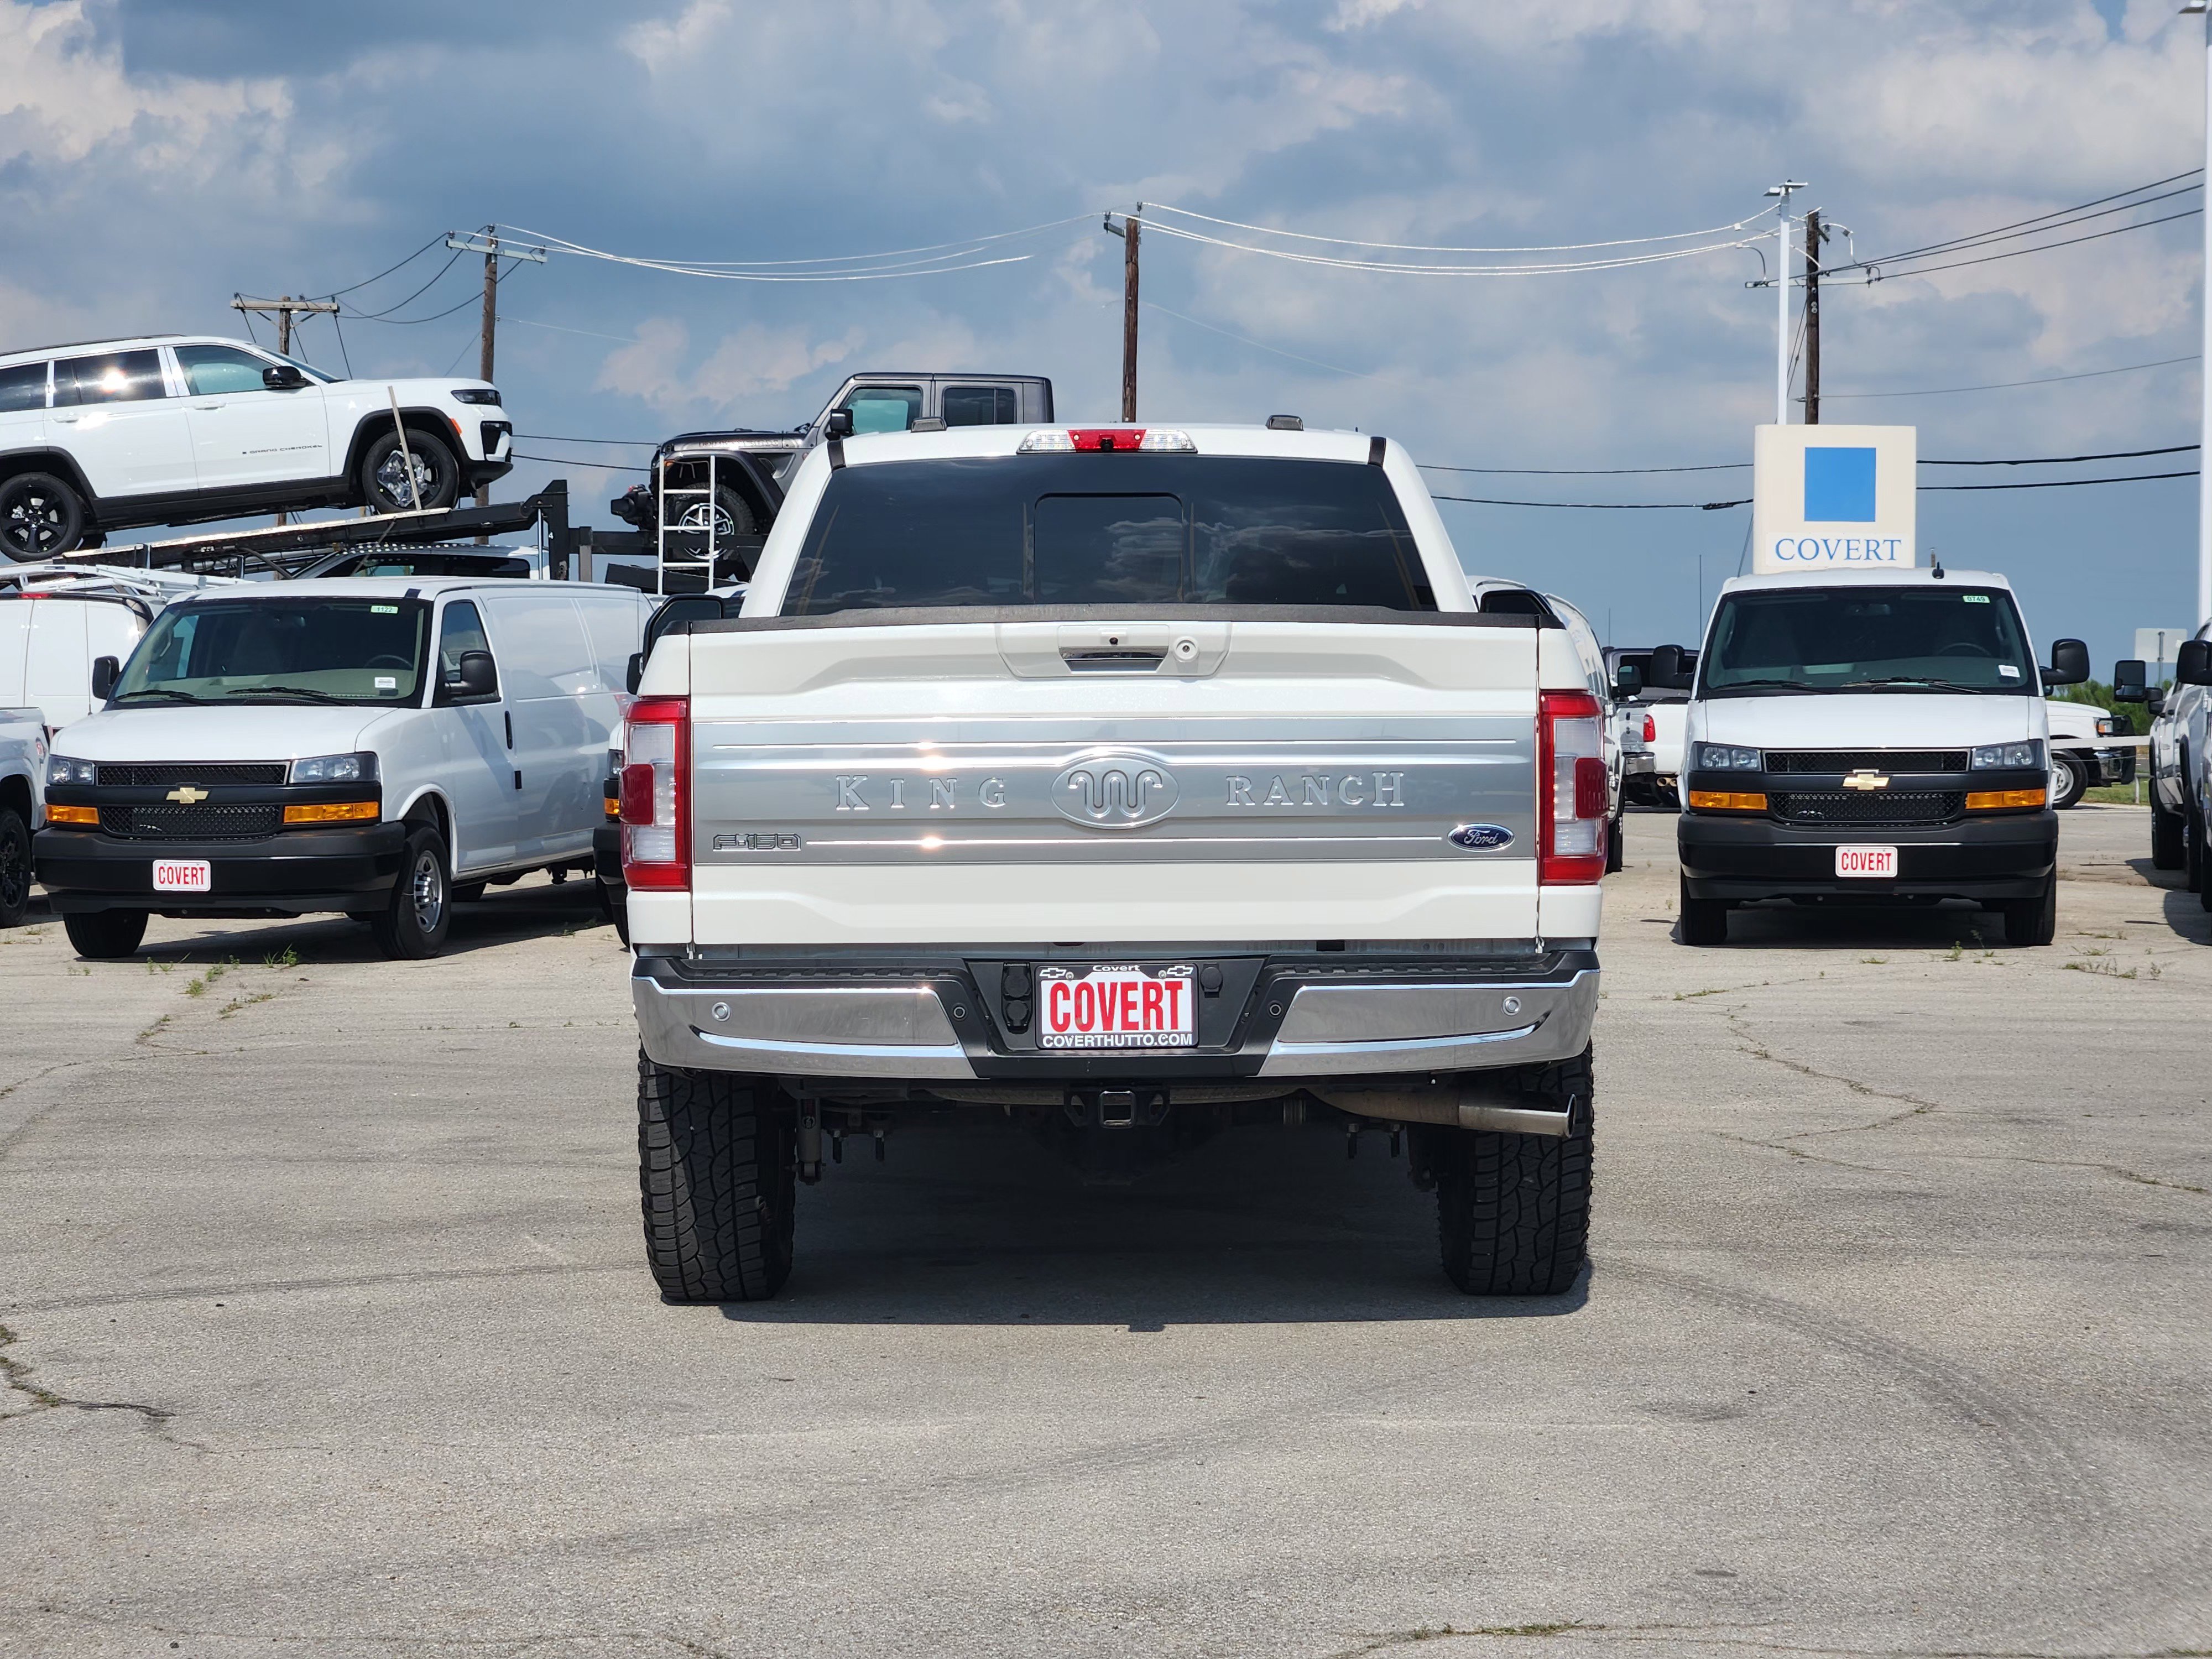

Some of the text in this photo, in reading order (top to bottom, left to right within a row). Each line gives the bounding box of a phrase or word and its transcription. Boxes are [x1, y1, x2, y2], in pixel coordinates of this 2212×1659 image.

[1775, 538, 1901, 561] COVERT
[836, 771, 1405, 810] KING RANCH
[713, 834, 801, 851] F-150
[1463, 830, 1499, 844] Ford
[1841, 852, 1892, 870] COVERT
[159, 866, 205, 885] COVERT
[1050, 981, 1183, 1032] COVERT
[1042, 1034, 1192, 1047] COVERTHUTTO.COM
